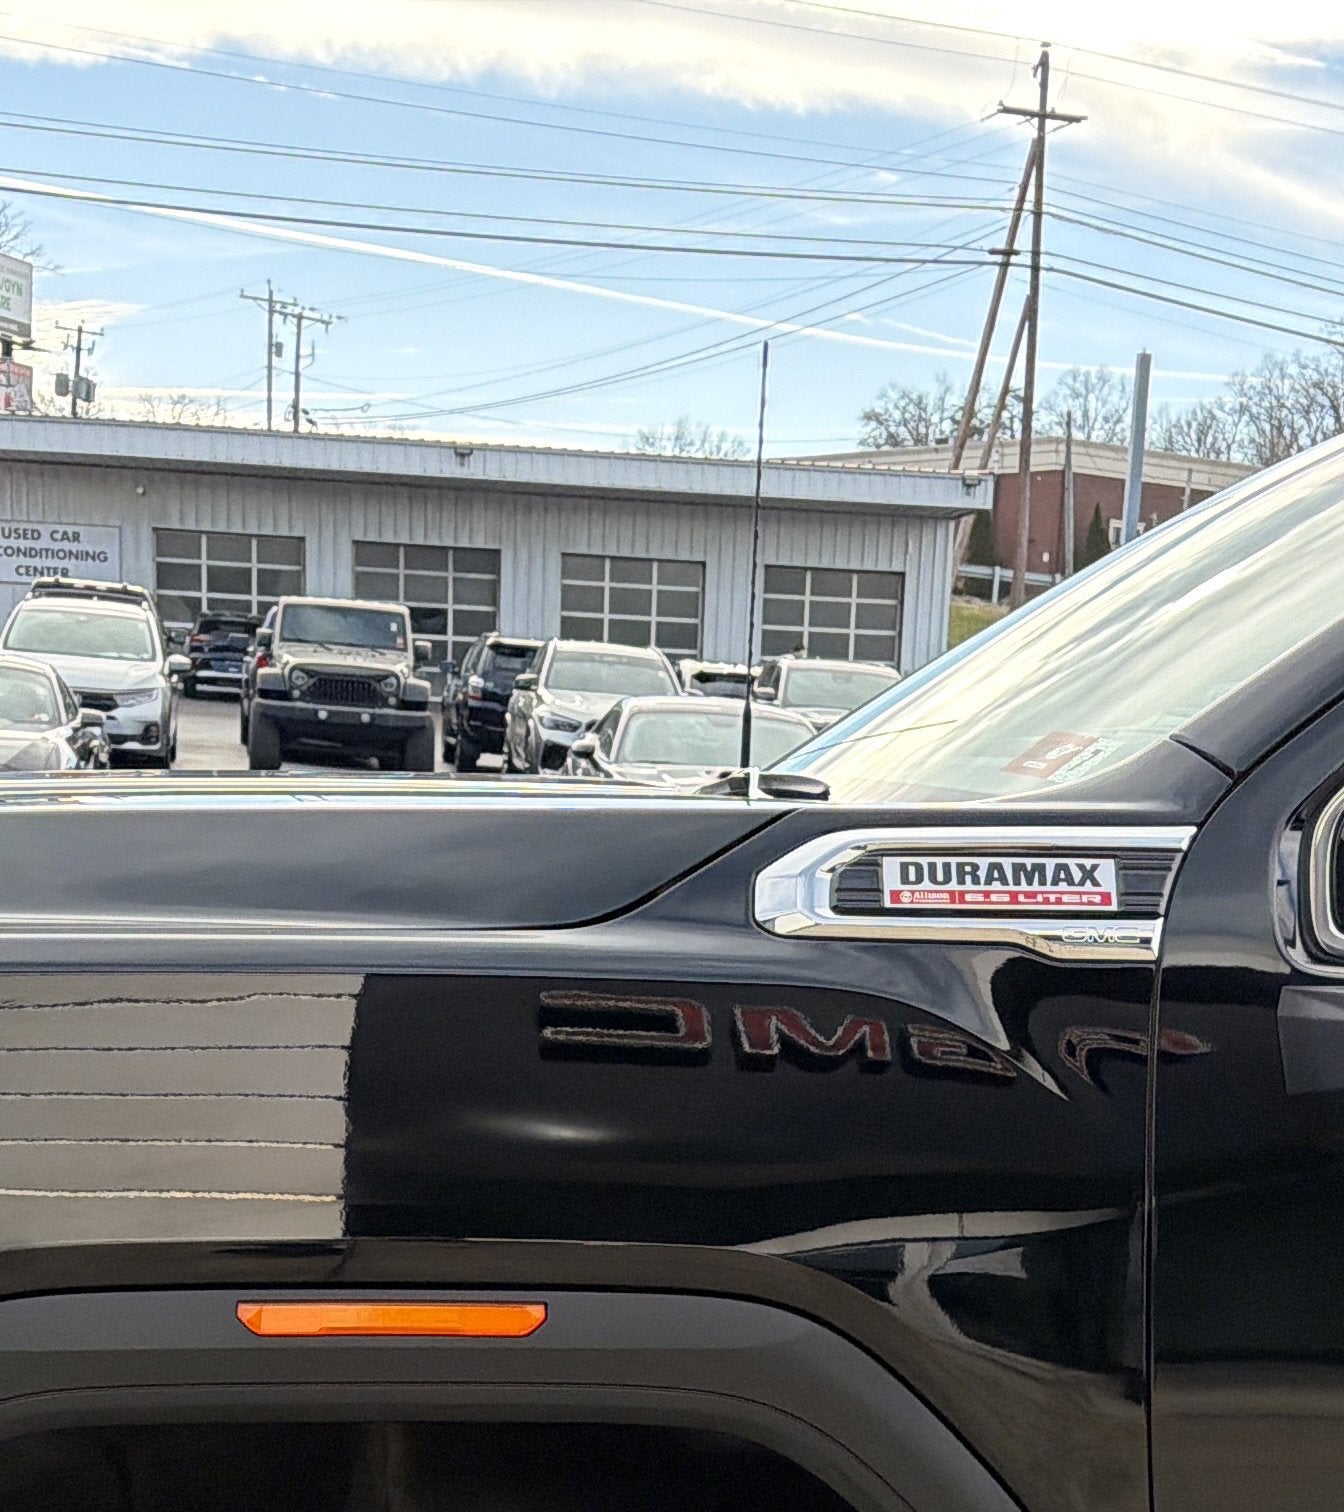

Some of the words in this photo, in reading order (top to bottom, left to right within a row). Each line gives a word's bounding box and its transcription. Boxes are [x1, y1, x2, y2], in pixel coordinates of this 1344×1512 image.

[0, 526, 42, 541] USED
[49, 529, 82, 544] CAR
[14, 564, 70, 578] CENTER
[899, 861, 1103, 887] DURAMAX
[964, 893, 1011, 903] 6.6
[1017, 893, 1102, 904] LITER
[1061, 926, 1141, 944] GMC
